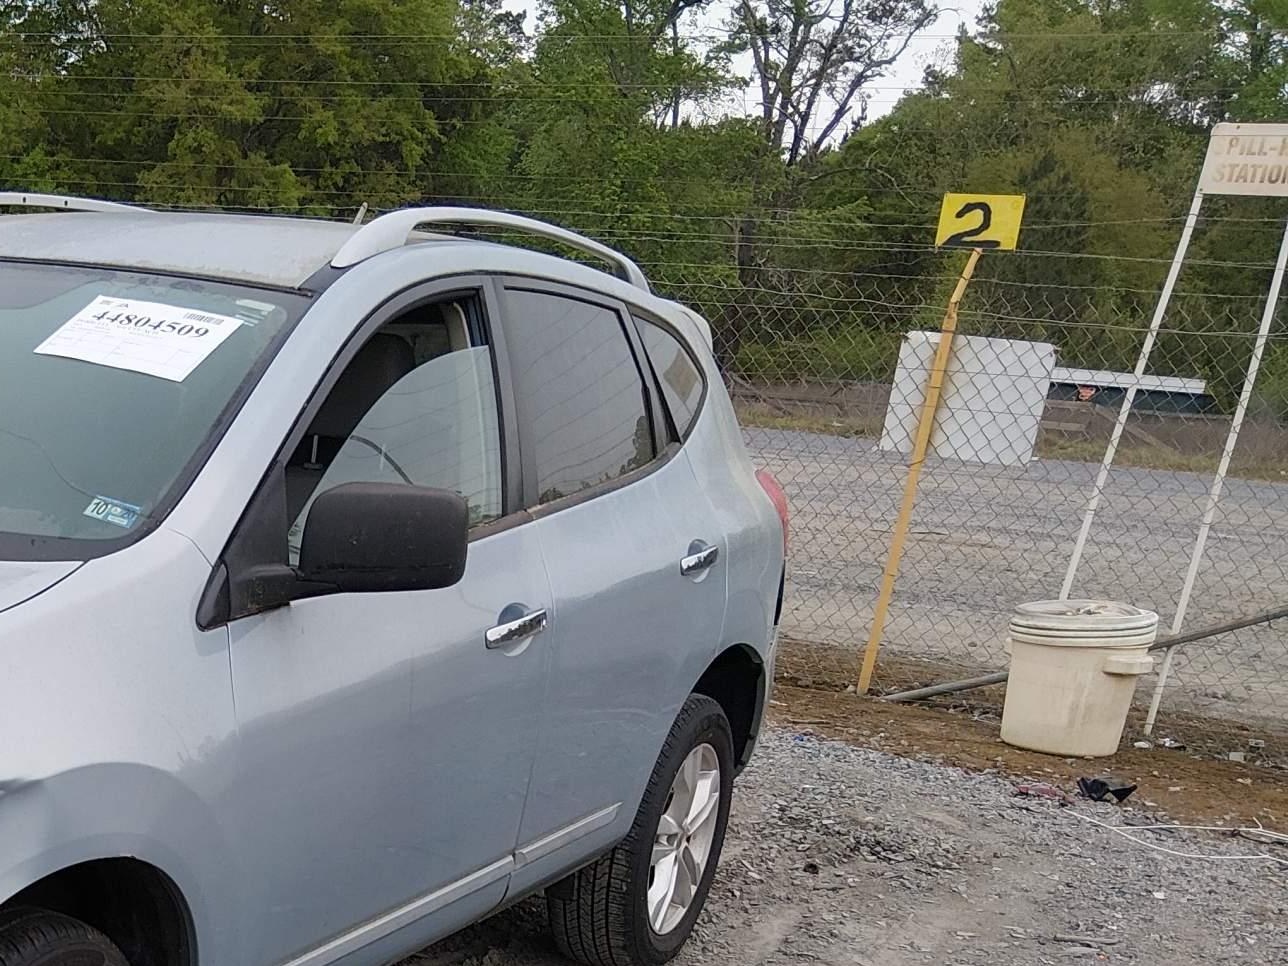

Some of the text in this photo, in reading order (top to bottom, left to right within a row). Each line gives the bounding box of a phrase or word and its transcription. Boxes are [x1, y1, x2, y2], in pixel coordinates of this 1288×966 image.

[941, 202, 1001, 249] 2
[91, 310, 210, 338] 44804509
[91, 501, 109, 516] 10
